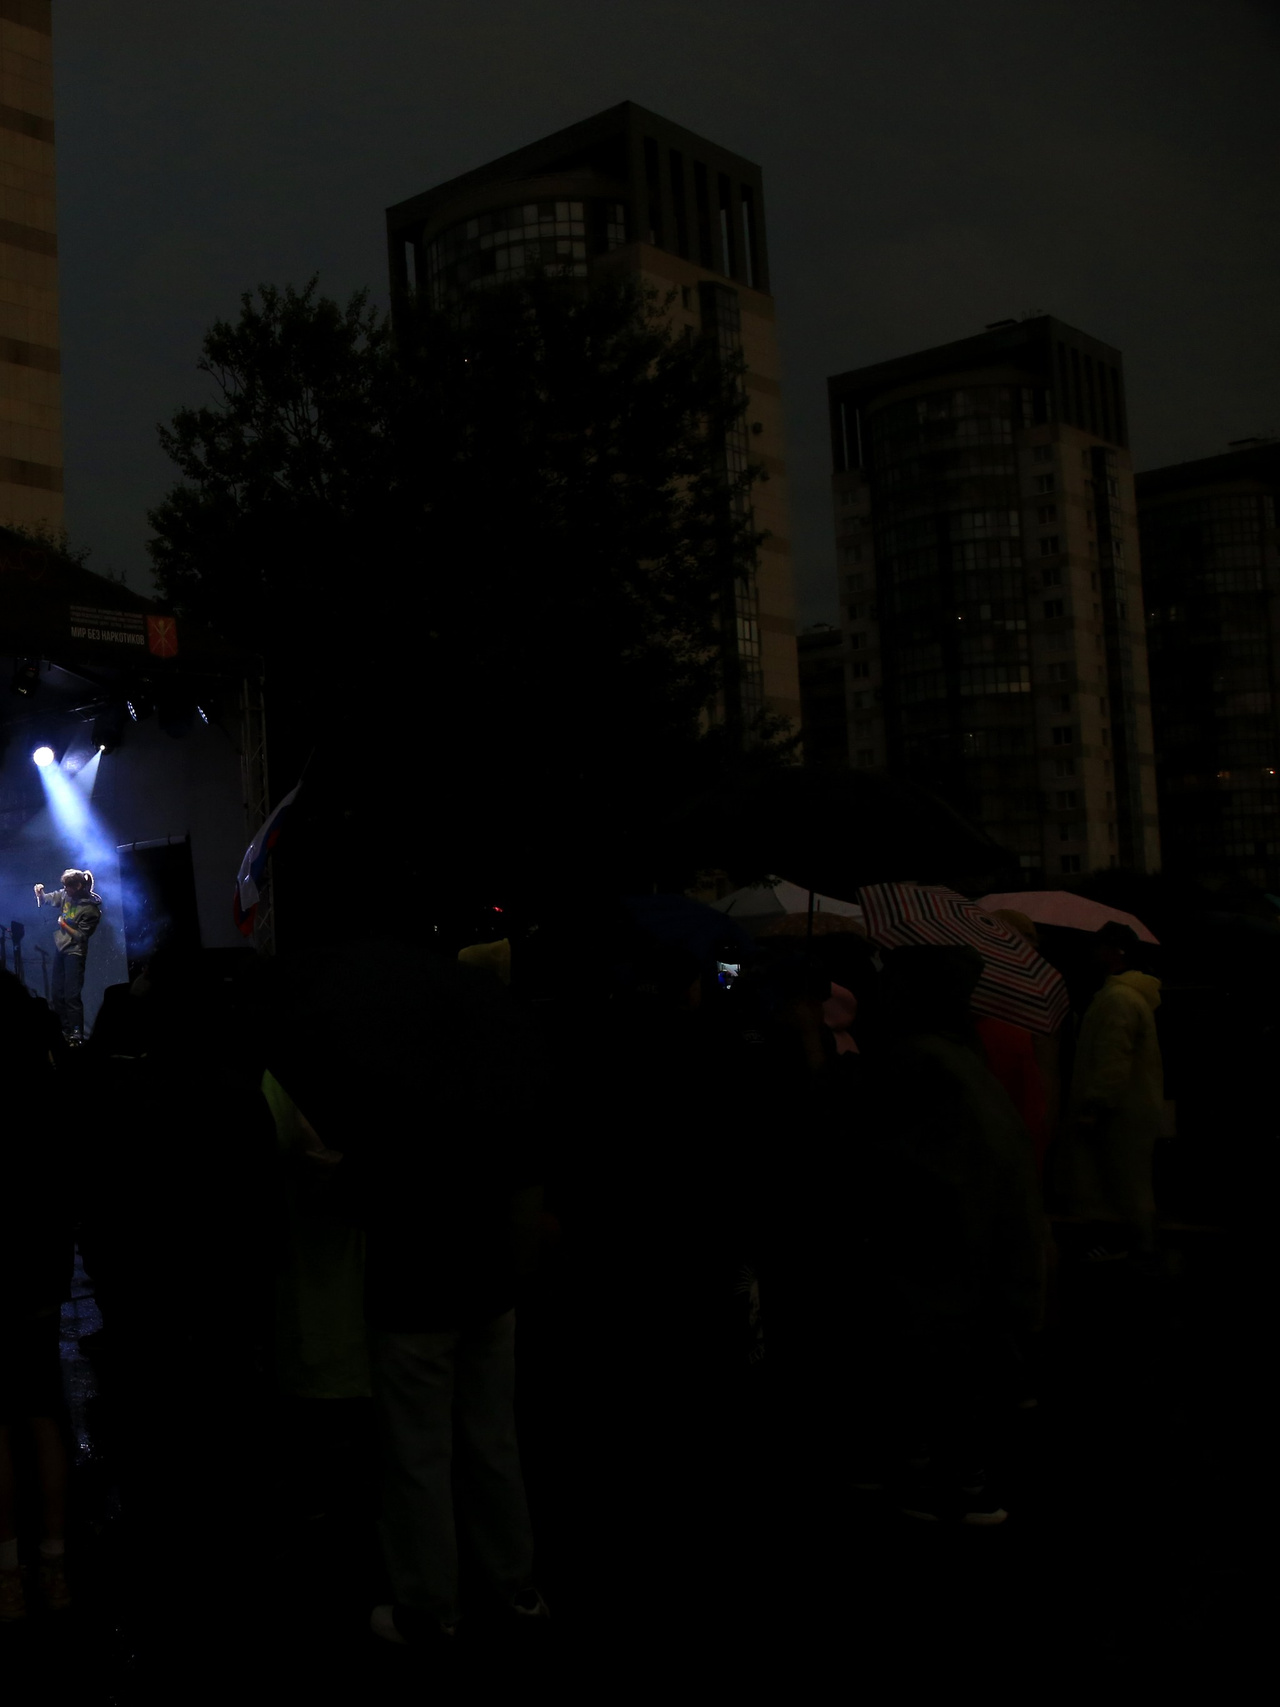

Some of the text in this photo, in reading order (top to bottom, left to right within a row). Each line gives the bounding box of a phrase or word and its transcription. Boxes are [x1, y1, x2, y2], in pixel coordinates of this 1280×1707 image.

[71, 626, 145, 645] МИР БЕЗ НАРКОТИКОВ
